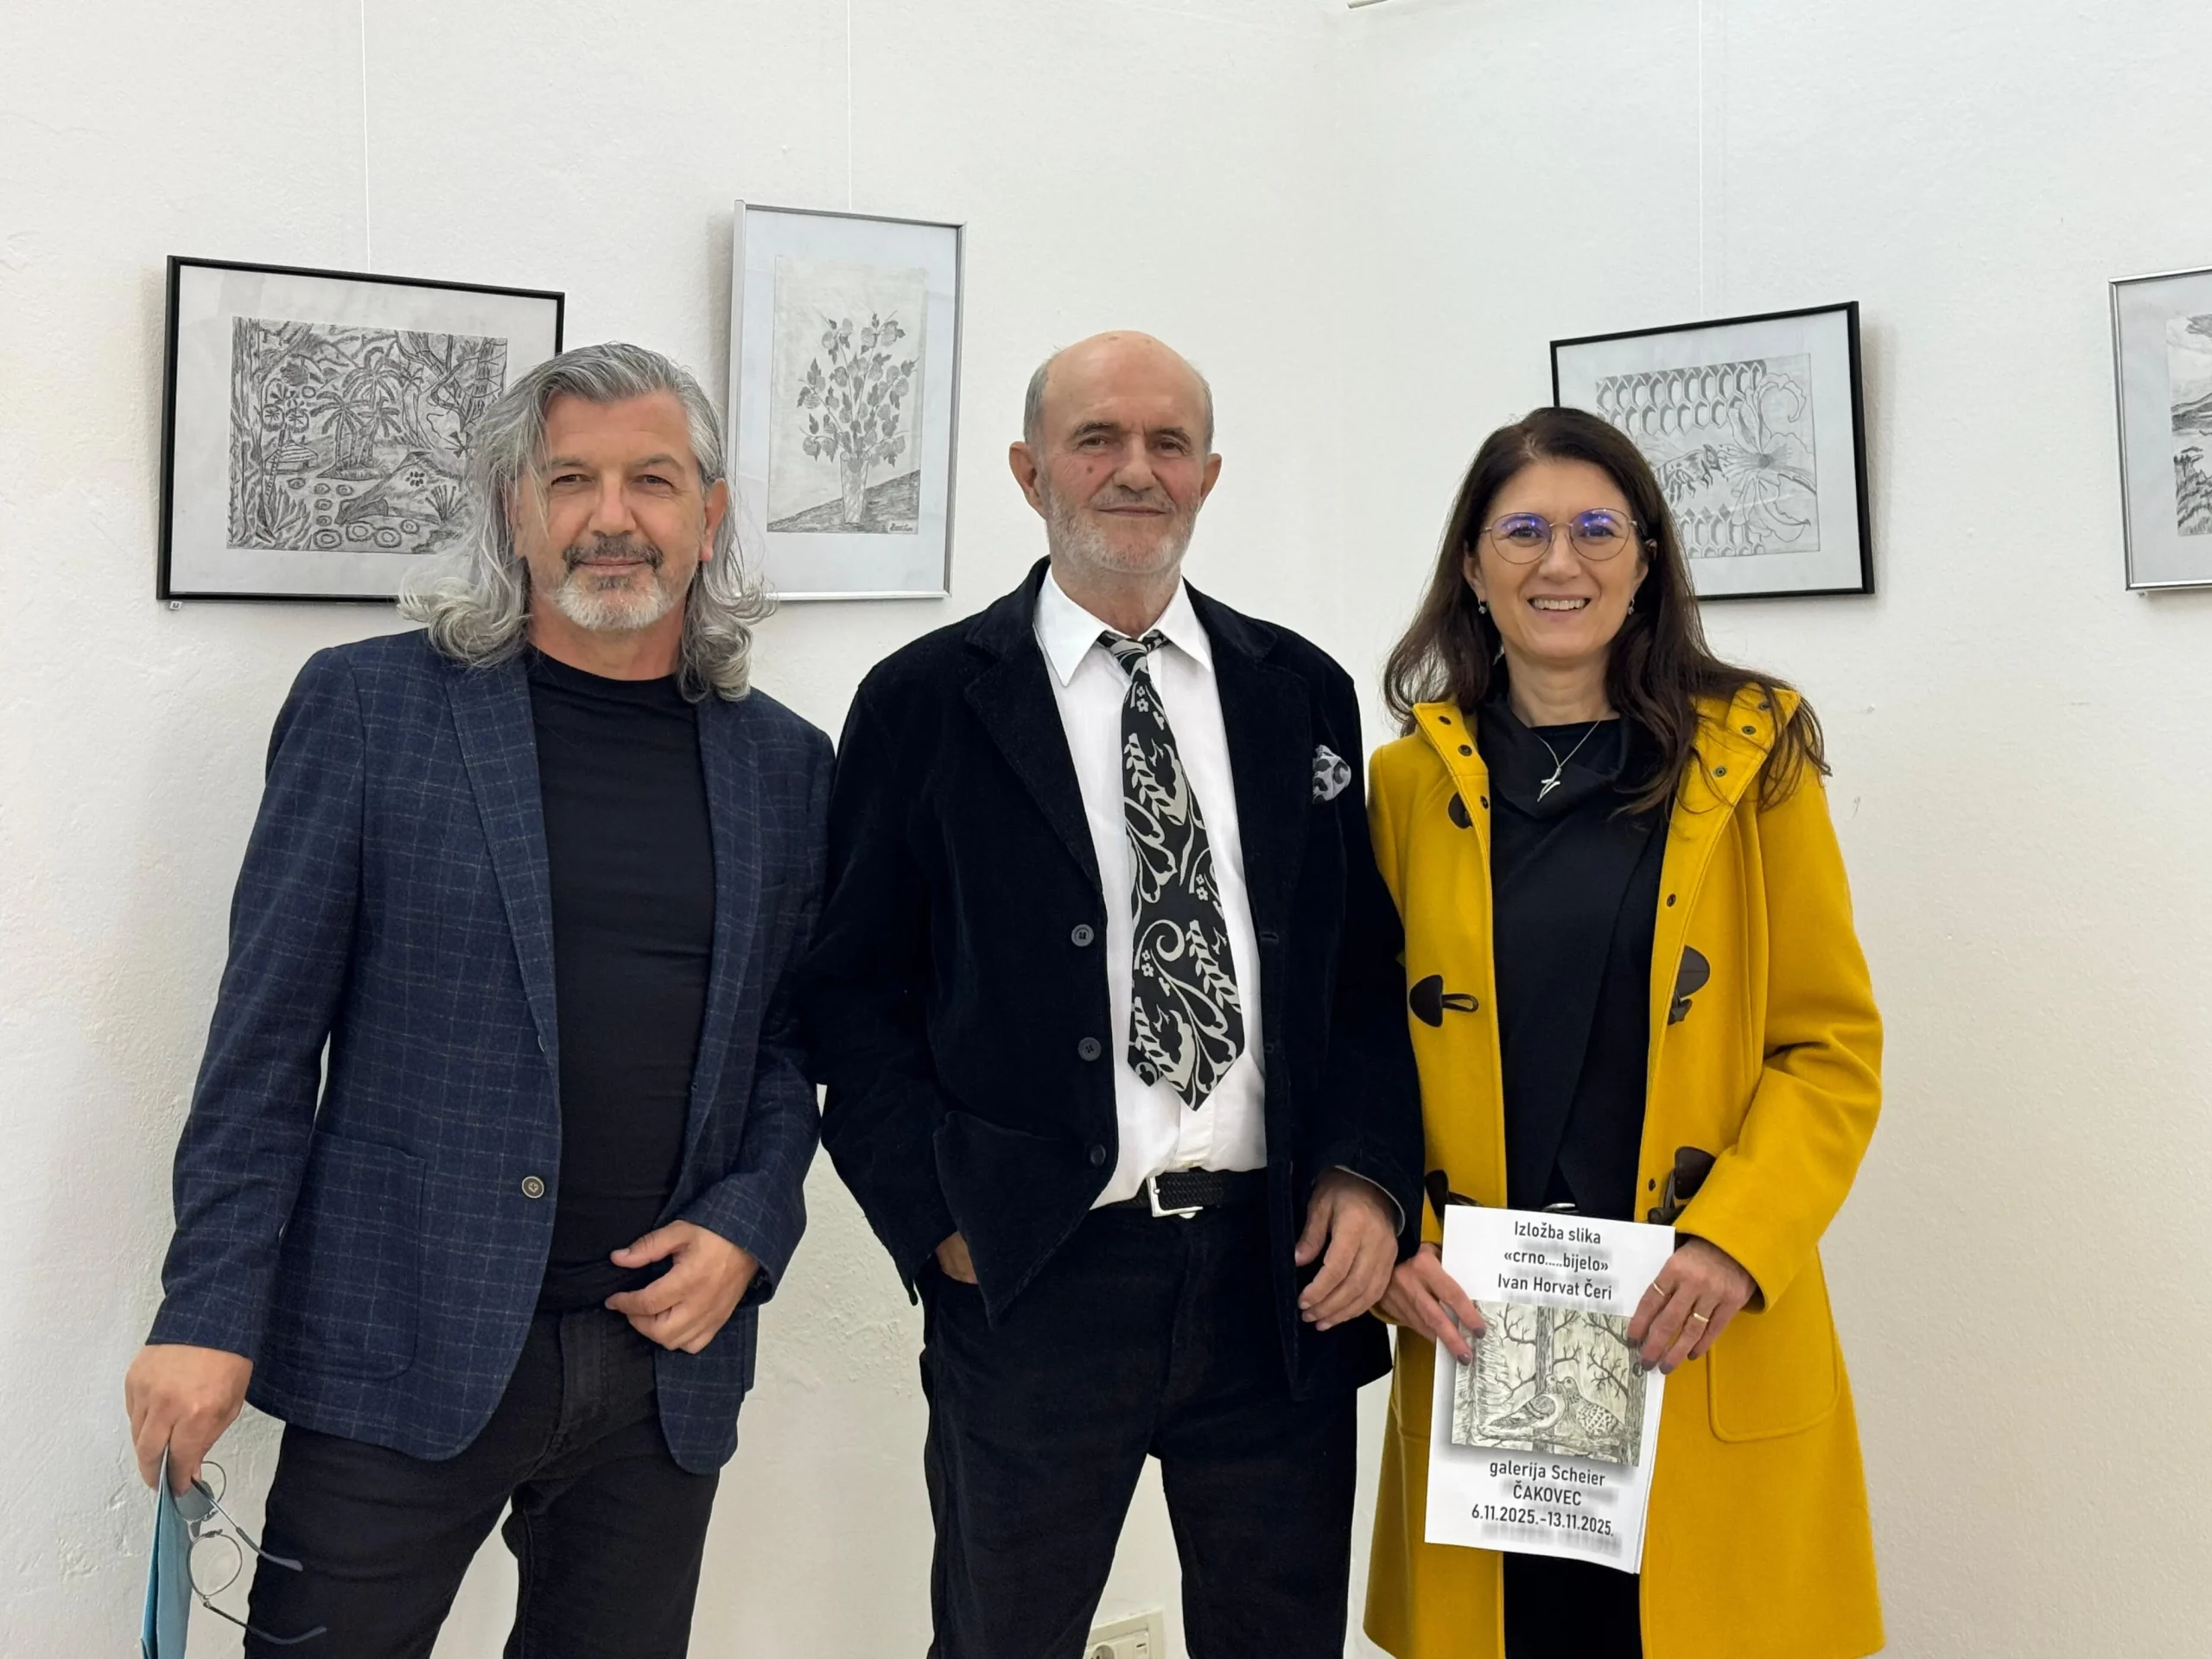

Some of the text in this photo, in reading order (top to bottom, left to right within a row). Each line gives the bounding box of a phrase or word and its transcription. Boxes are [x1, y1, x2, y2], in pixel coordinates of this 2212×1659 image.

[1515, 1221, 1601, 1244] Izložba slika
[1497, 1273, 1612, 1300] Ivan Horvat Čeri
[1490, 1460, 1606, 1486] galerija Scheier
[1513, 1479, 1582, 1506] ČAKOVEC
